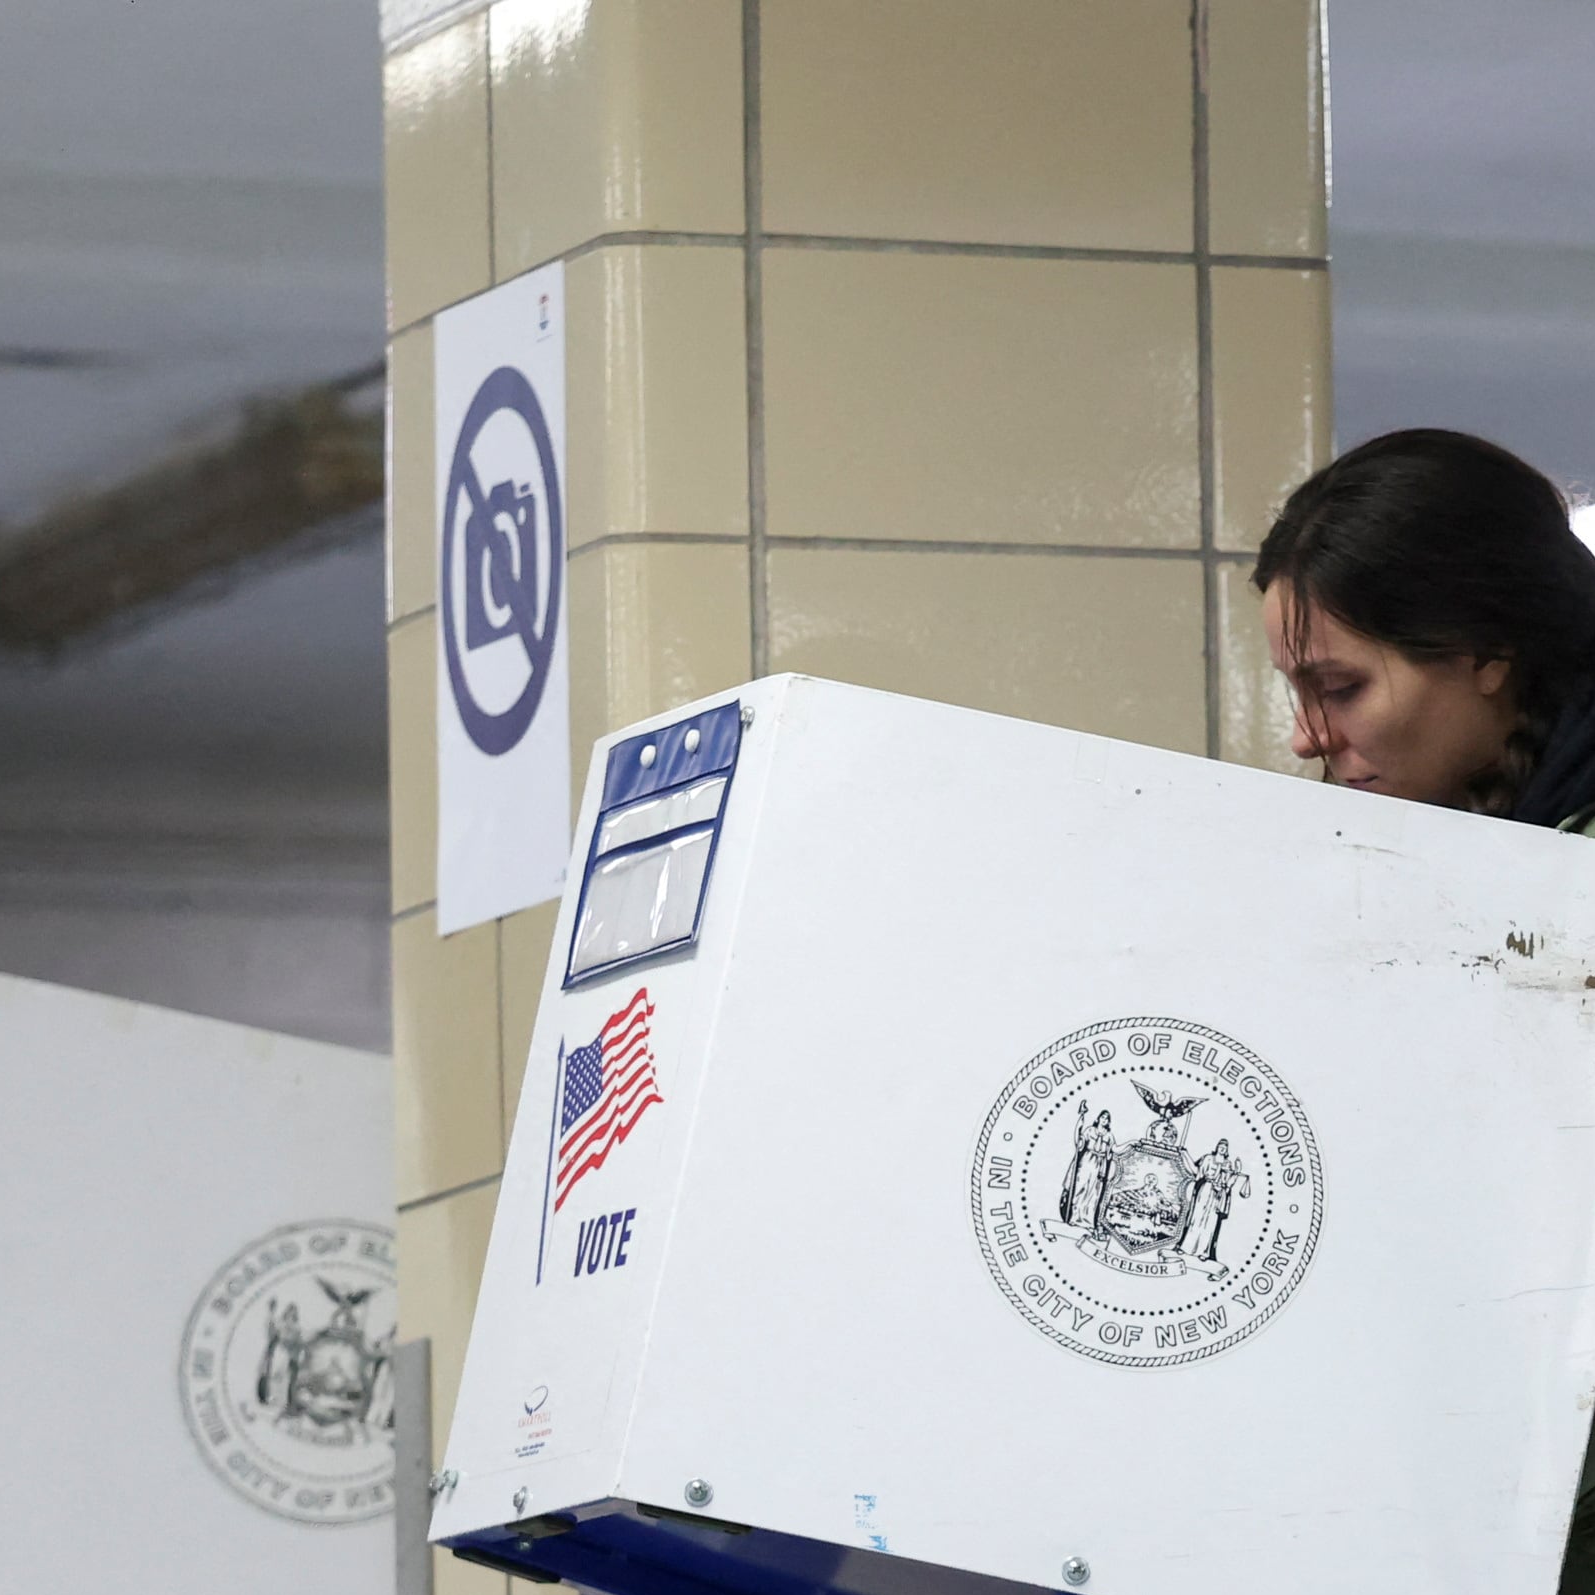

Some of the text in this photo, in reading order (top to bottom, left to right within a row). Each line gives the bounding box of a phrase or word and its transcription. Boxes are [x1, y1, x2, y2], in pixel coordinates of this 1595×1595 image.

[1013, 1033, 1306, 1188] BOARD OF ELECTIONS
[574, 1208, 637, 1278] VOTE
[989, 1154, 1300, 1348] IN THE CITY OF NEW YORK
[1093, 1249, 1169, 1275] EXCELSIOR
